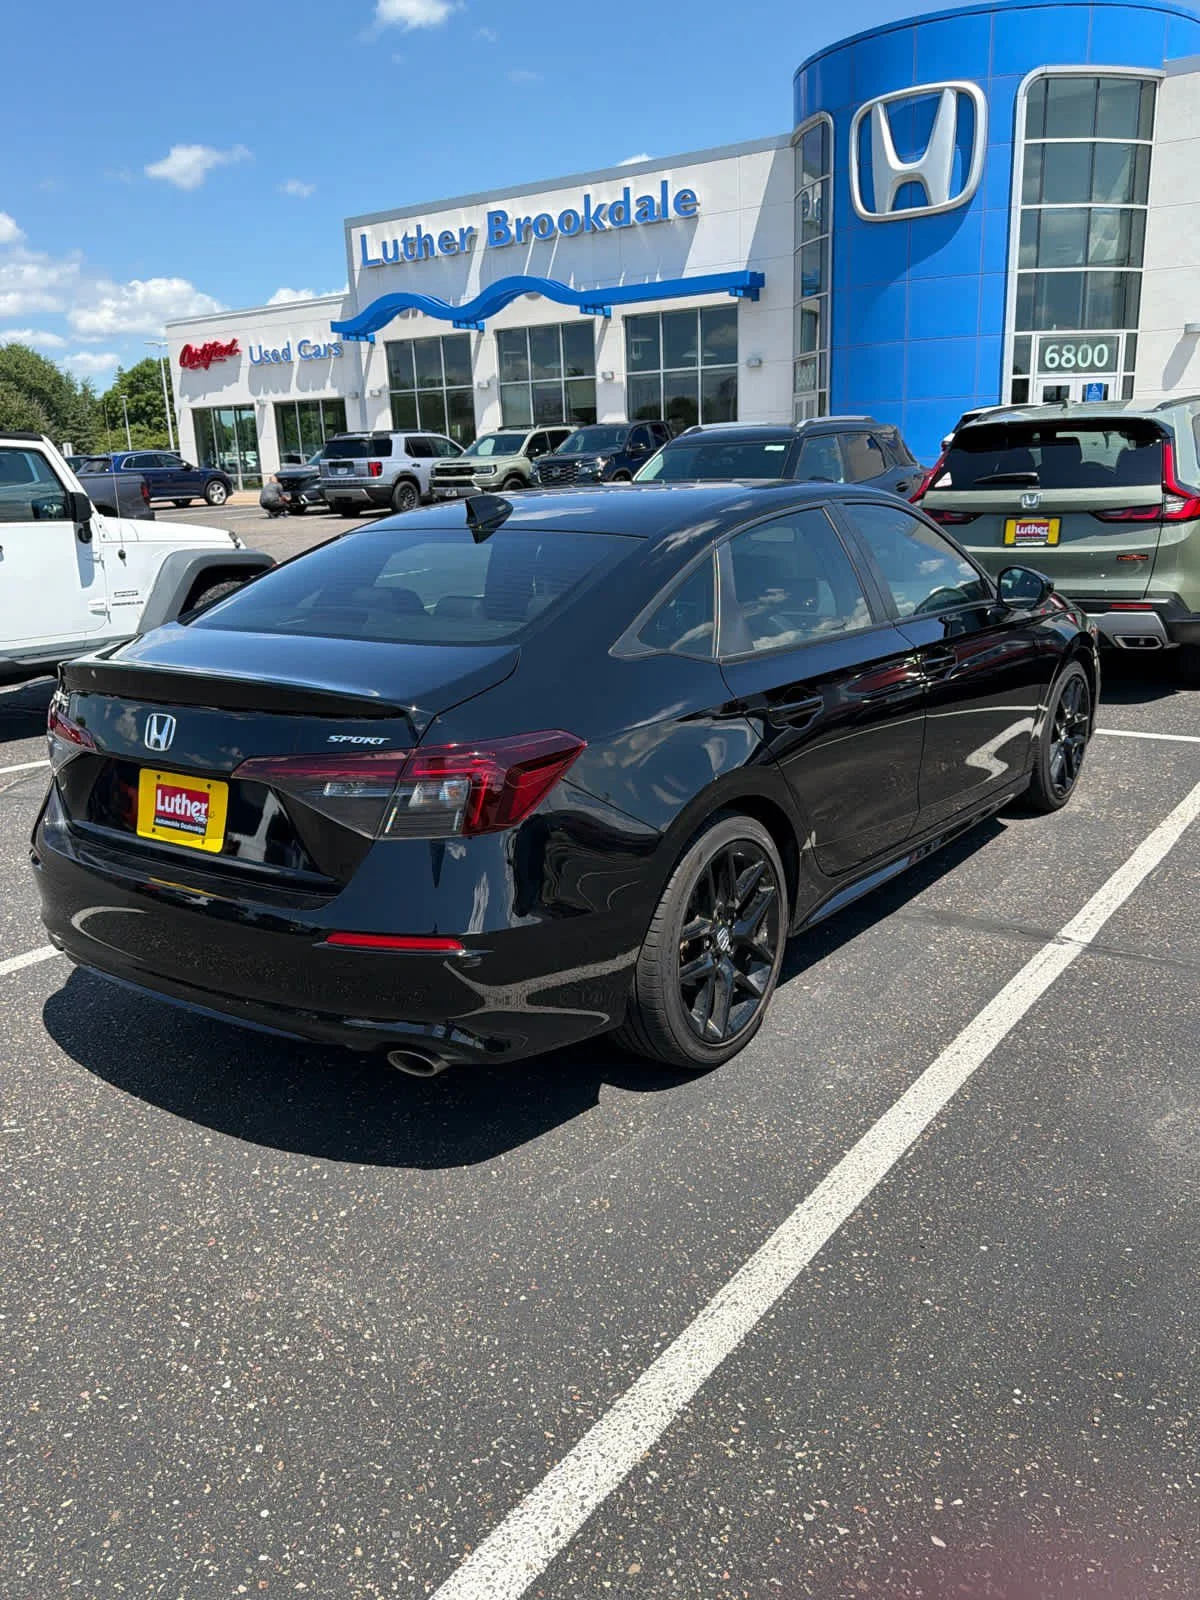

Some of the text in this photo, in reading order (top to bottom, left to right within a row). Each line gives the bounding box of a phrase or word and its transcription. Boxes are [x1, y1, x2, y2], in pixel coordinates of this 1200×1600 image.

[360, 180, 699, 267] Luther Brookdale
[249, 340, 292, 365] Used
[297, 339, 342, 361] Cars
[1044, 343, 1109, 369] 6800
[1016, 524, 1048, 535] Luther
[327, 735, 391, 745] SPORT
[157, 789, 208, 818] Luther
